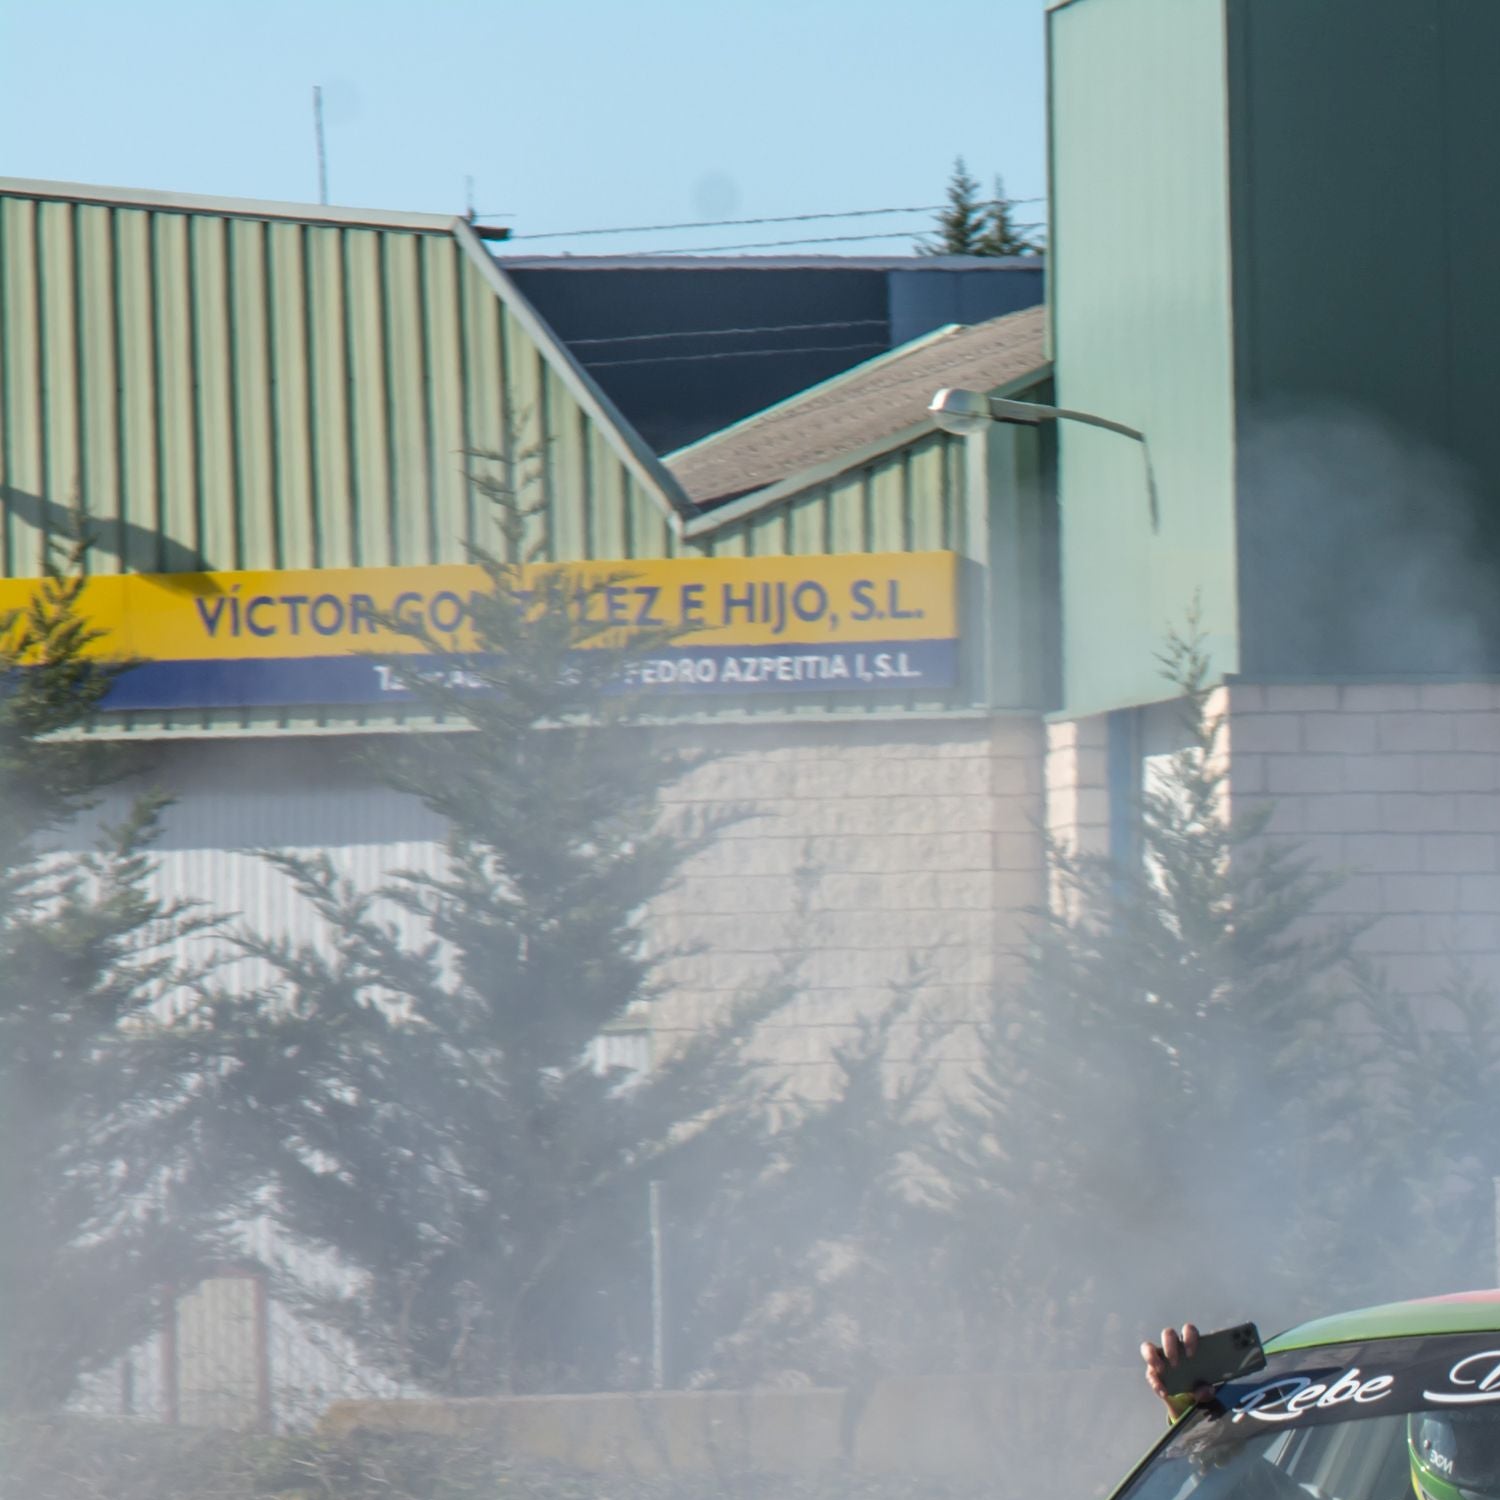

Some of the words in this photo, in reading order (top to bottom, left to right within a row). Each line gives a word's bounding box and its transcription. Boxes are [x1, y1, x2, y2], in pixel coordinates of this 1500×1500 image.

[195, 583, 377, 636] VÍCTOR
[393, 584, 663, 633] GOLEZ
[680, 583, 705, 625] E
[722, 579, 839, 634] HIJO,
[850, 578, 926, 622] S.L.
[720, 654, 849, 683] AZPEITIA
[1231, 1368, 1394, 1423] Rebe
